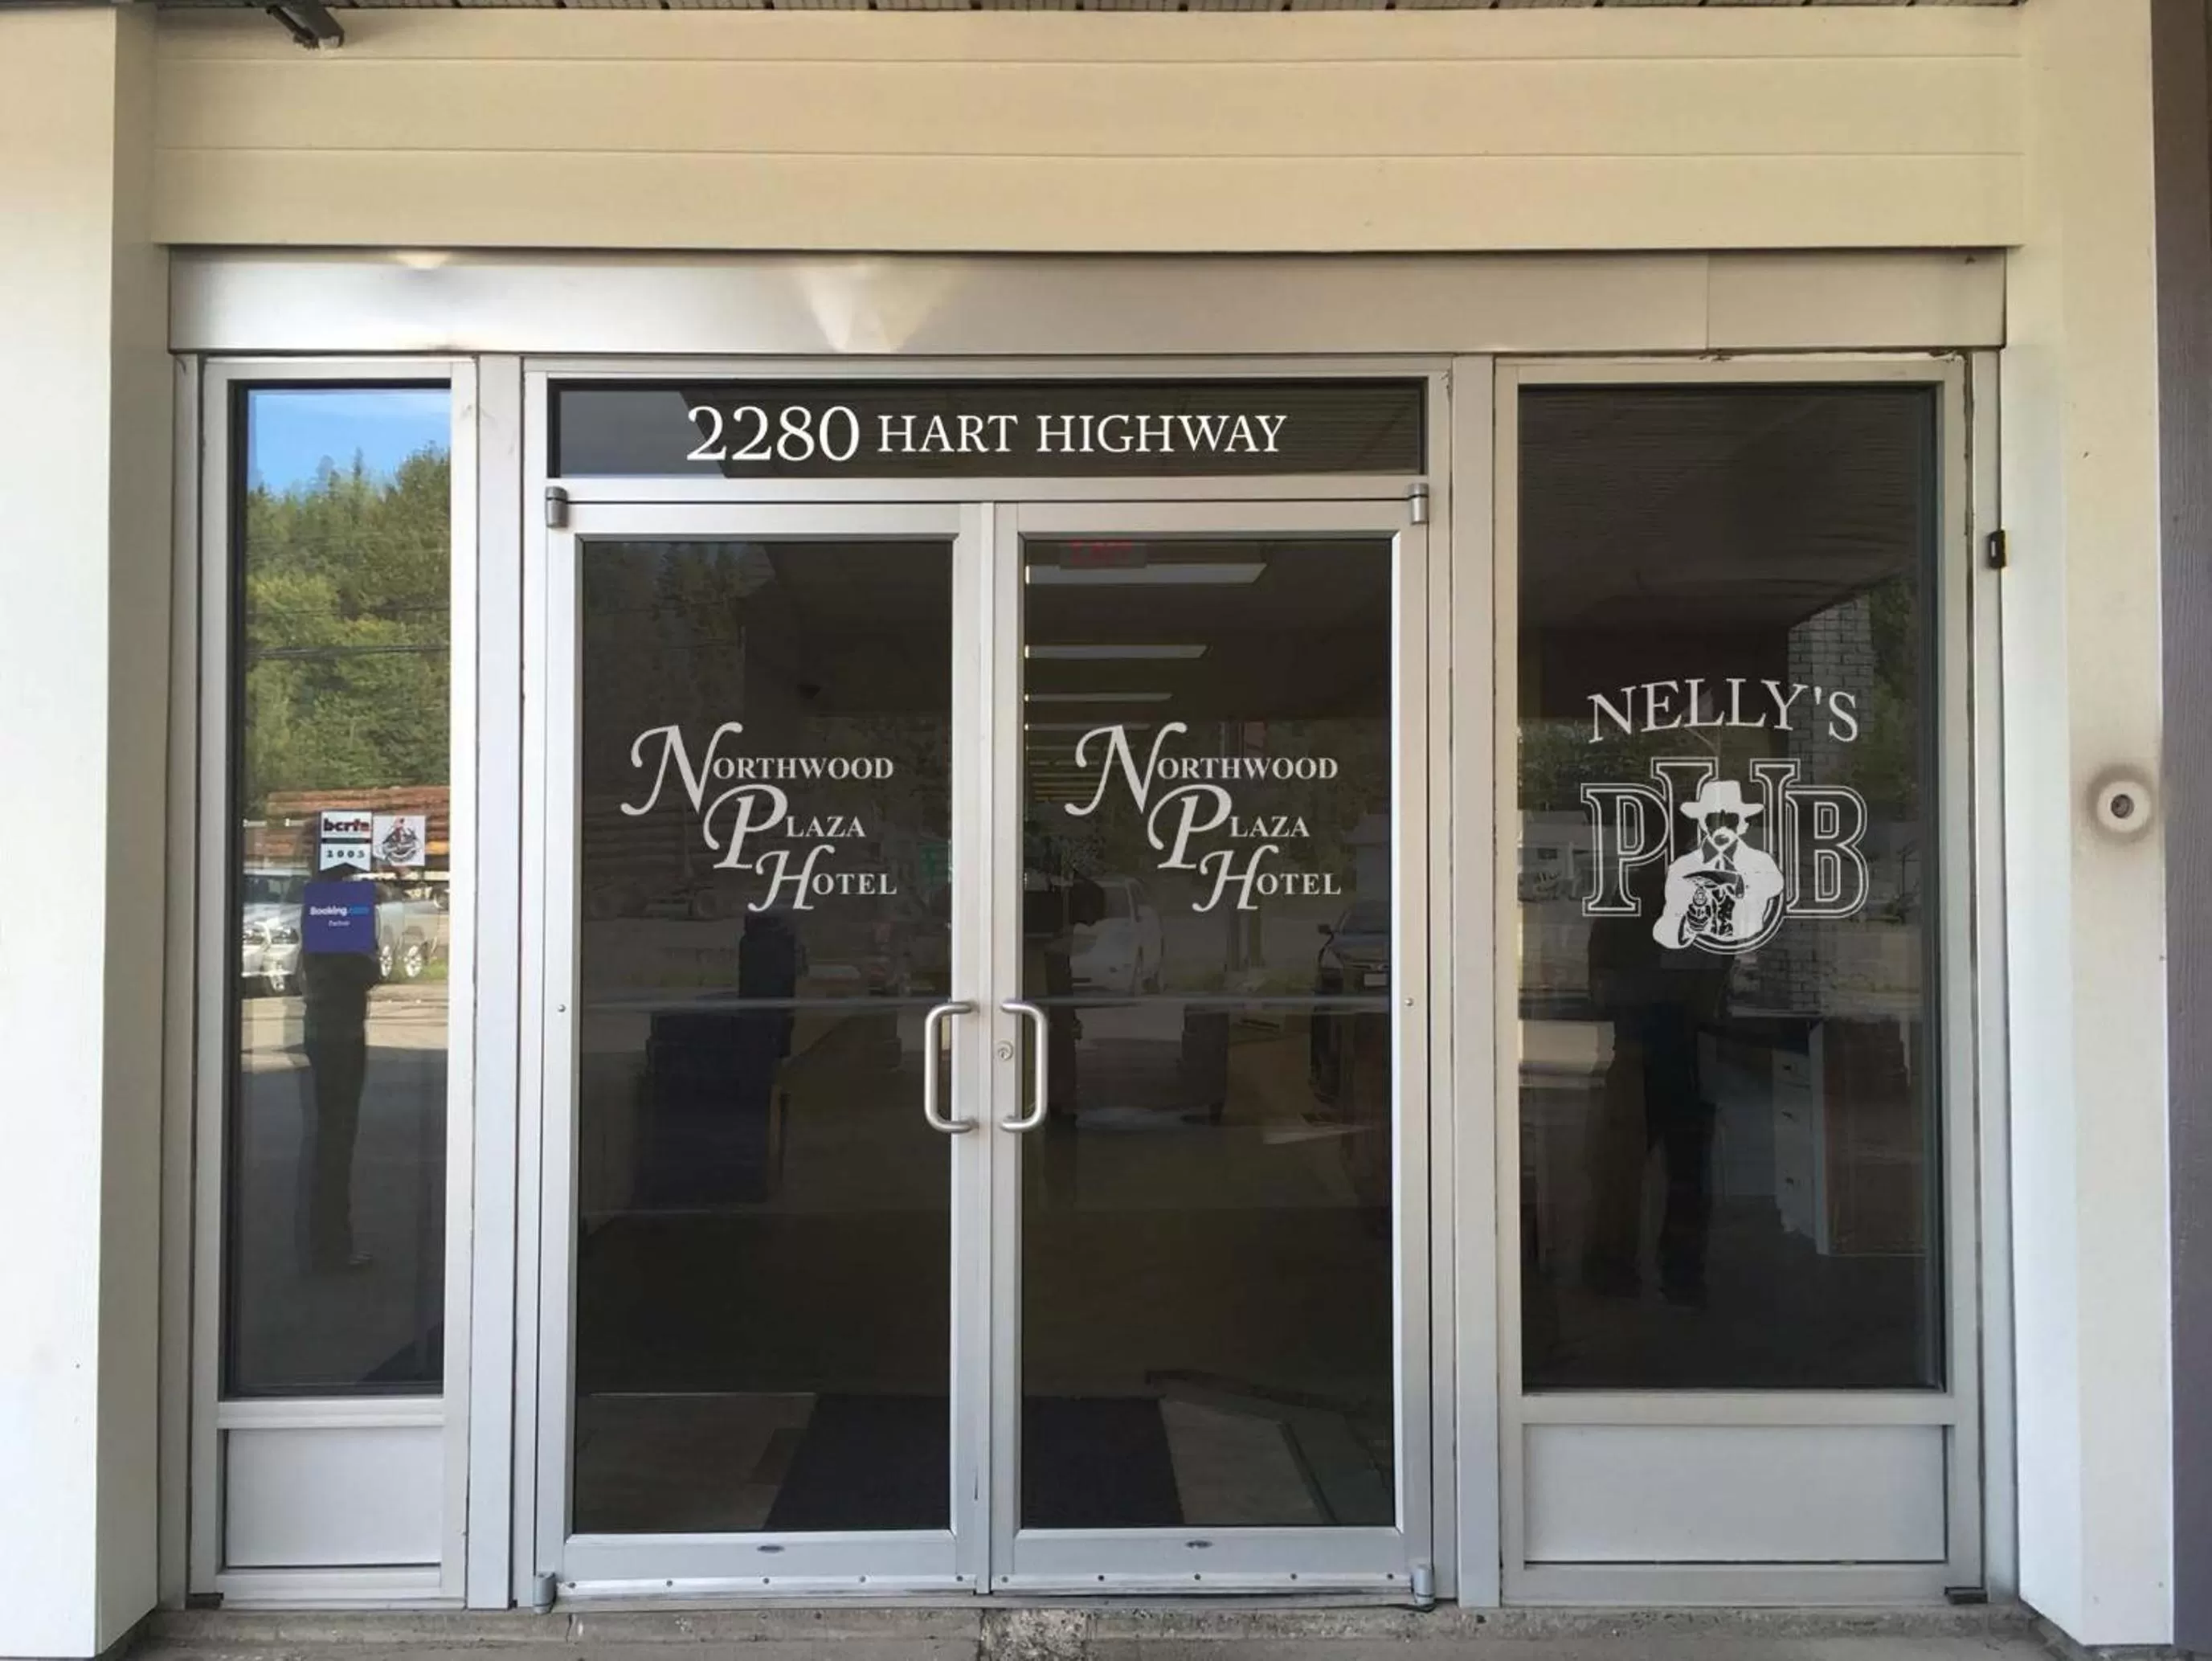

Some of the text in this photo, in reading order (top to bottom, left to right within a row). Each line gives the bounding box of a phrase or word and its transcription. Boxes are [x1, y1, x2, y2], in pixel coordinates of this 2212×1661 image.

[686, 406, 1286, 461] 2280 HART HIGHWAY
[1588, 678, 1858, 743] NELLY'S
[620, 722, 893, 816] NORTHWOOD
[1065, 722, 1338, 816] NORTHWOOD
[703, 783, 866, 869] PLAZA
[1147, 783, 1310, 869] PLAZA
[1580, 757, 1869, 955] PUB
[747, 845, 897, 912] HOTEL
[1192, 845, 1341, 912] HOTEL
